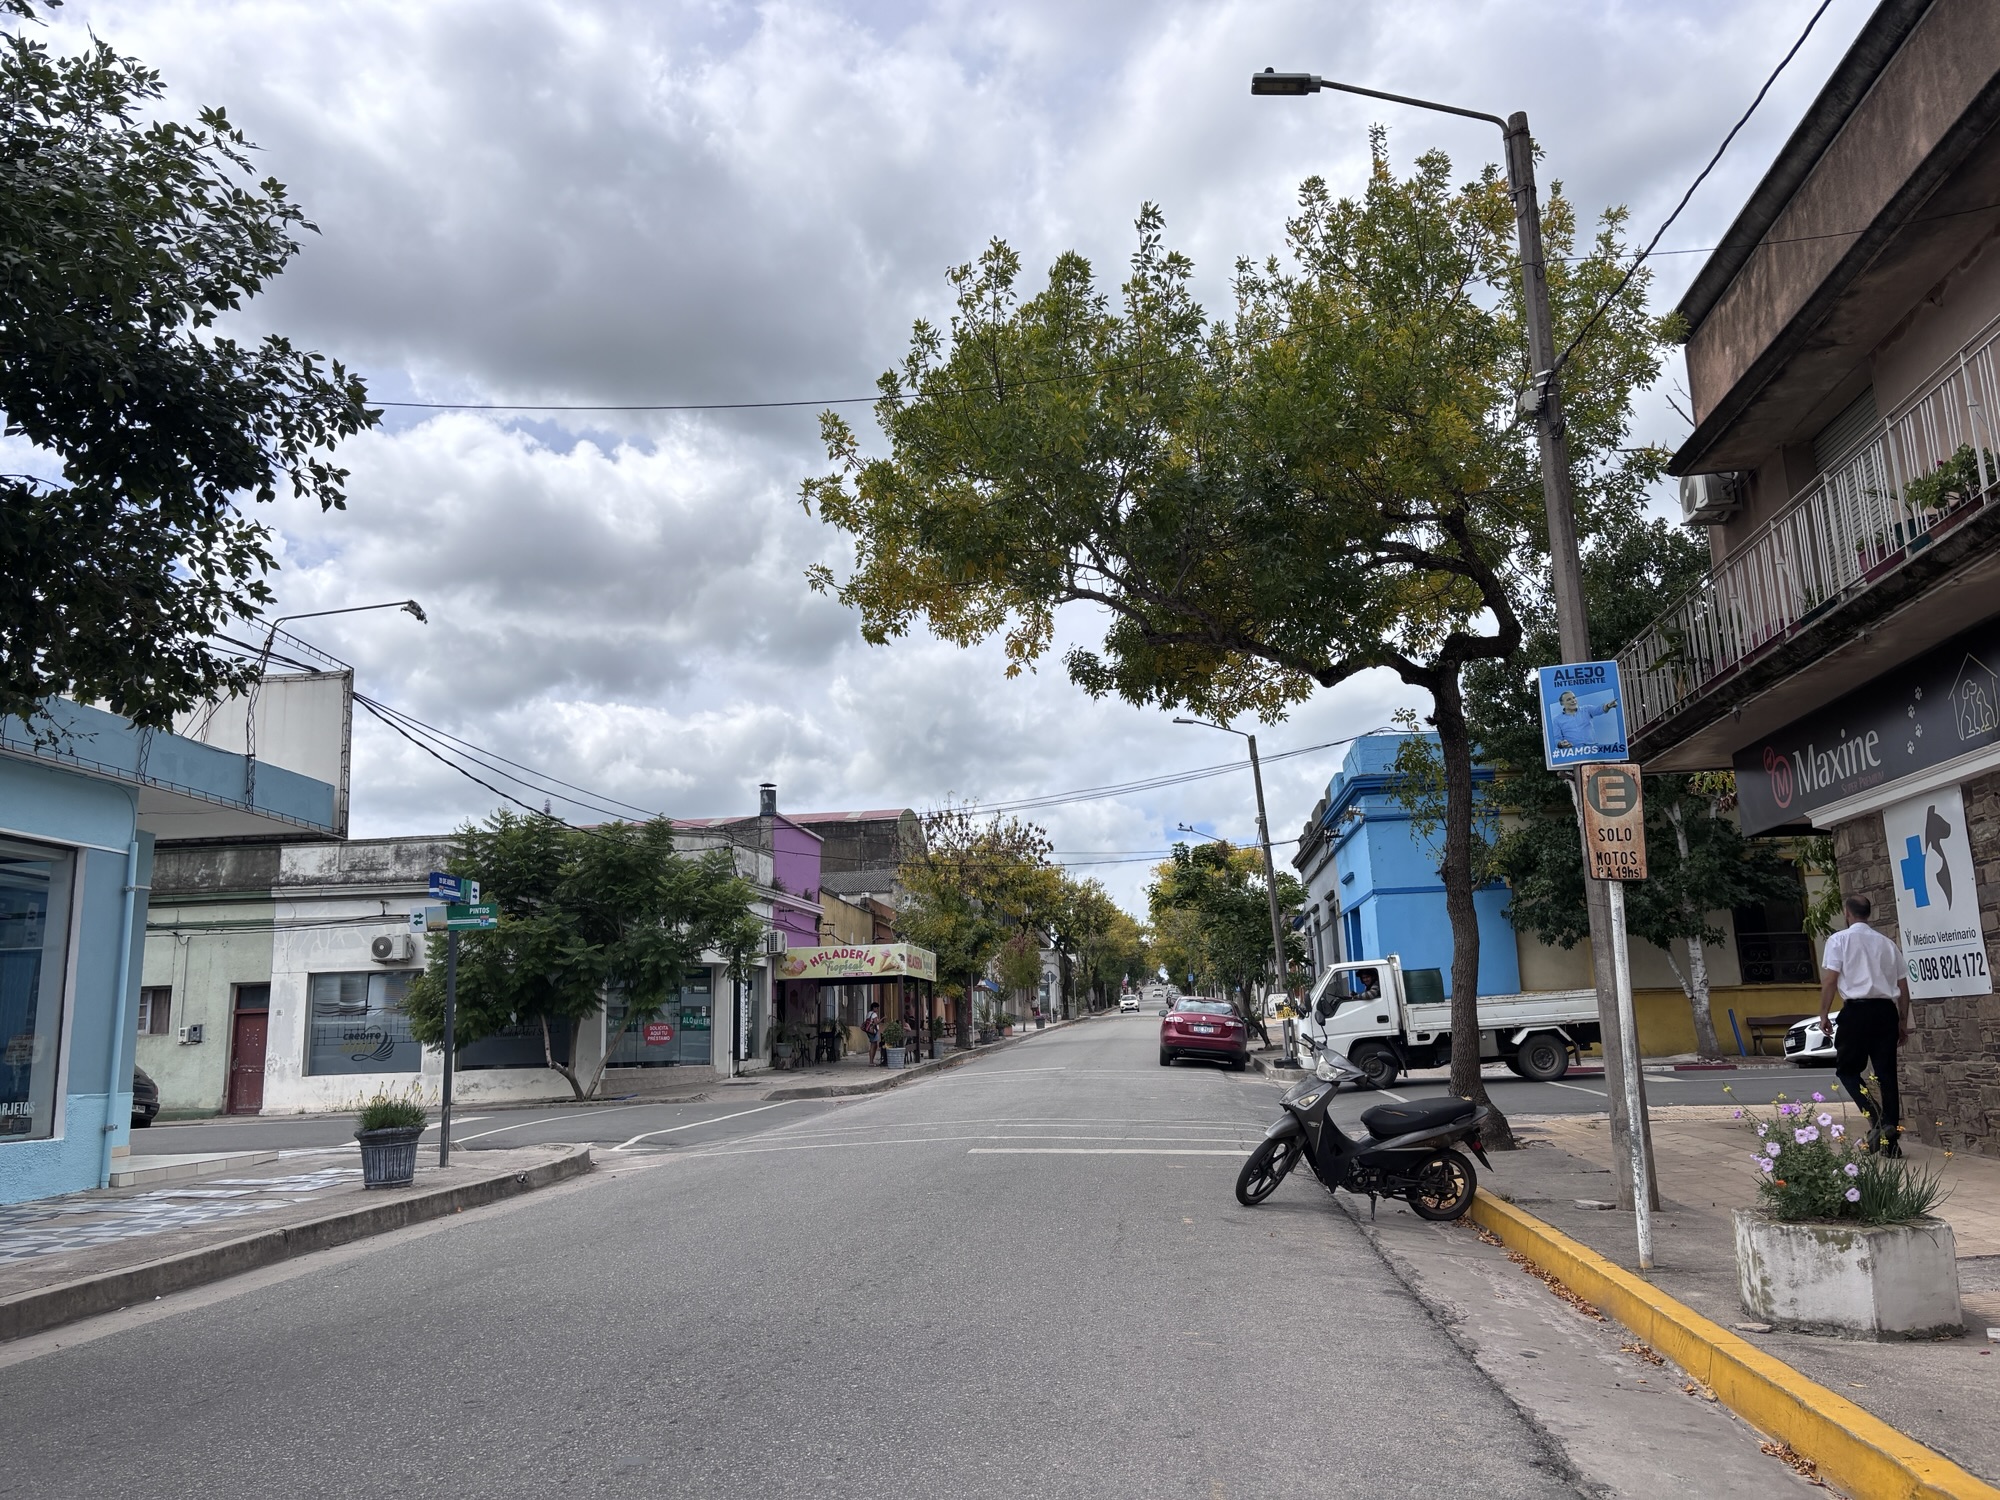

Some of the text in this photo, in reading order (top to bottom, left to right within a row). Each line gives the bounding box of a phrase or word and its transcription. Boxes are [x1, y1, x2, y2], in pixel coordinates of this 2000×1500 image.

[1554, 666, 1604, 681] ALEJO
[1554, 677, 1606, 688] INTENDENTE
[1792, 728, 1881, 796] Maxine
[1598, 776, 1627, 809] E
[1598, 828, 1632, 842] SOLO
[1596, 851, 1638, 866] MOTOS
[1607, 866, 1614, 878] A
[1616, 866, 1640, 878] 19hs
[1913, 926, 1976, 946] Médico Veterinario
[810, 948, 876, 968] HELADERÍA
[822, 958, 864, 975] Tropical
[1918, 952, 1986, 982] 098 824 172
[682, 1016, 710, 1026] ALQUILER
